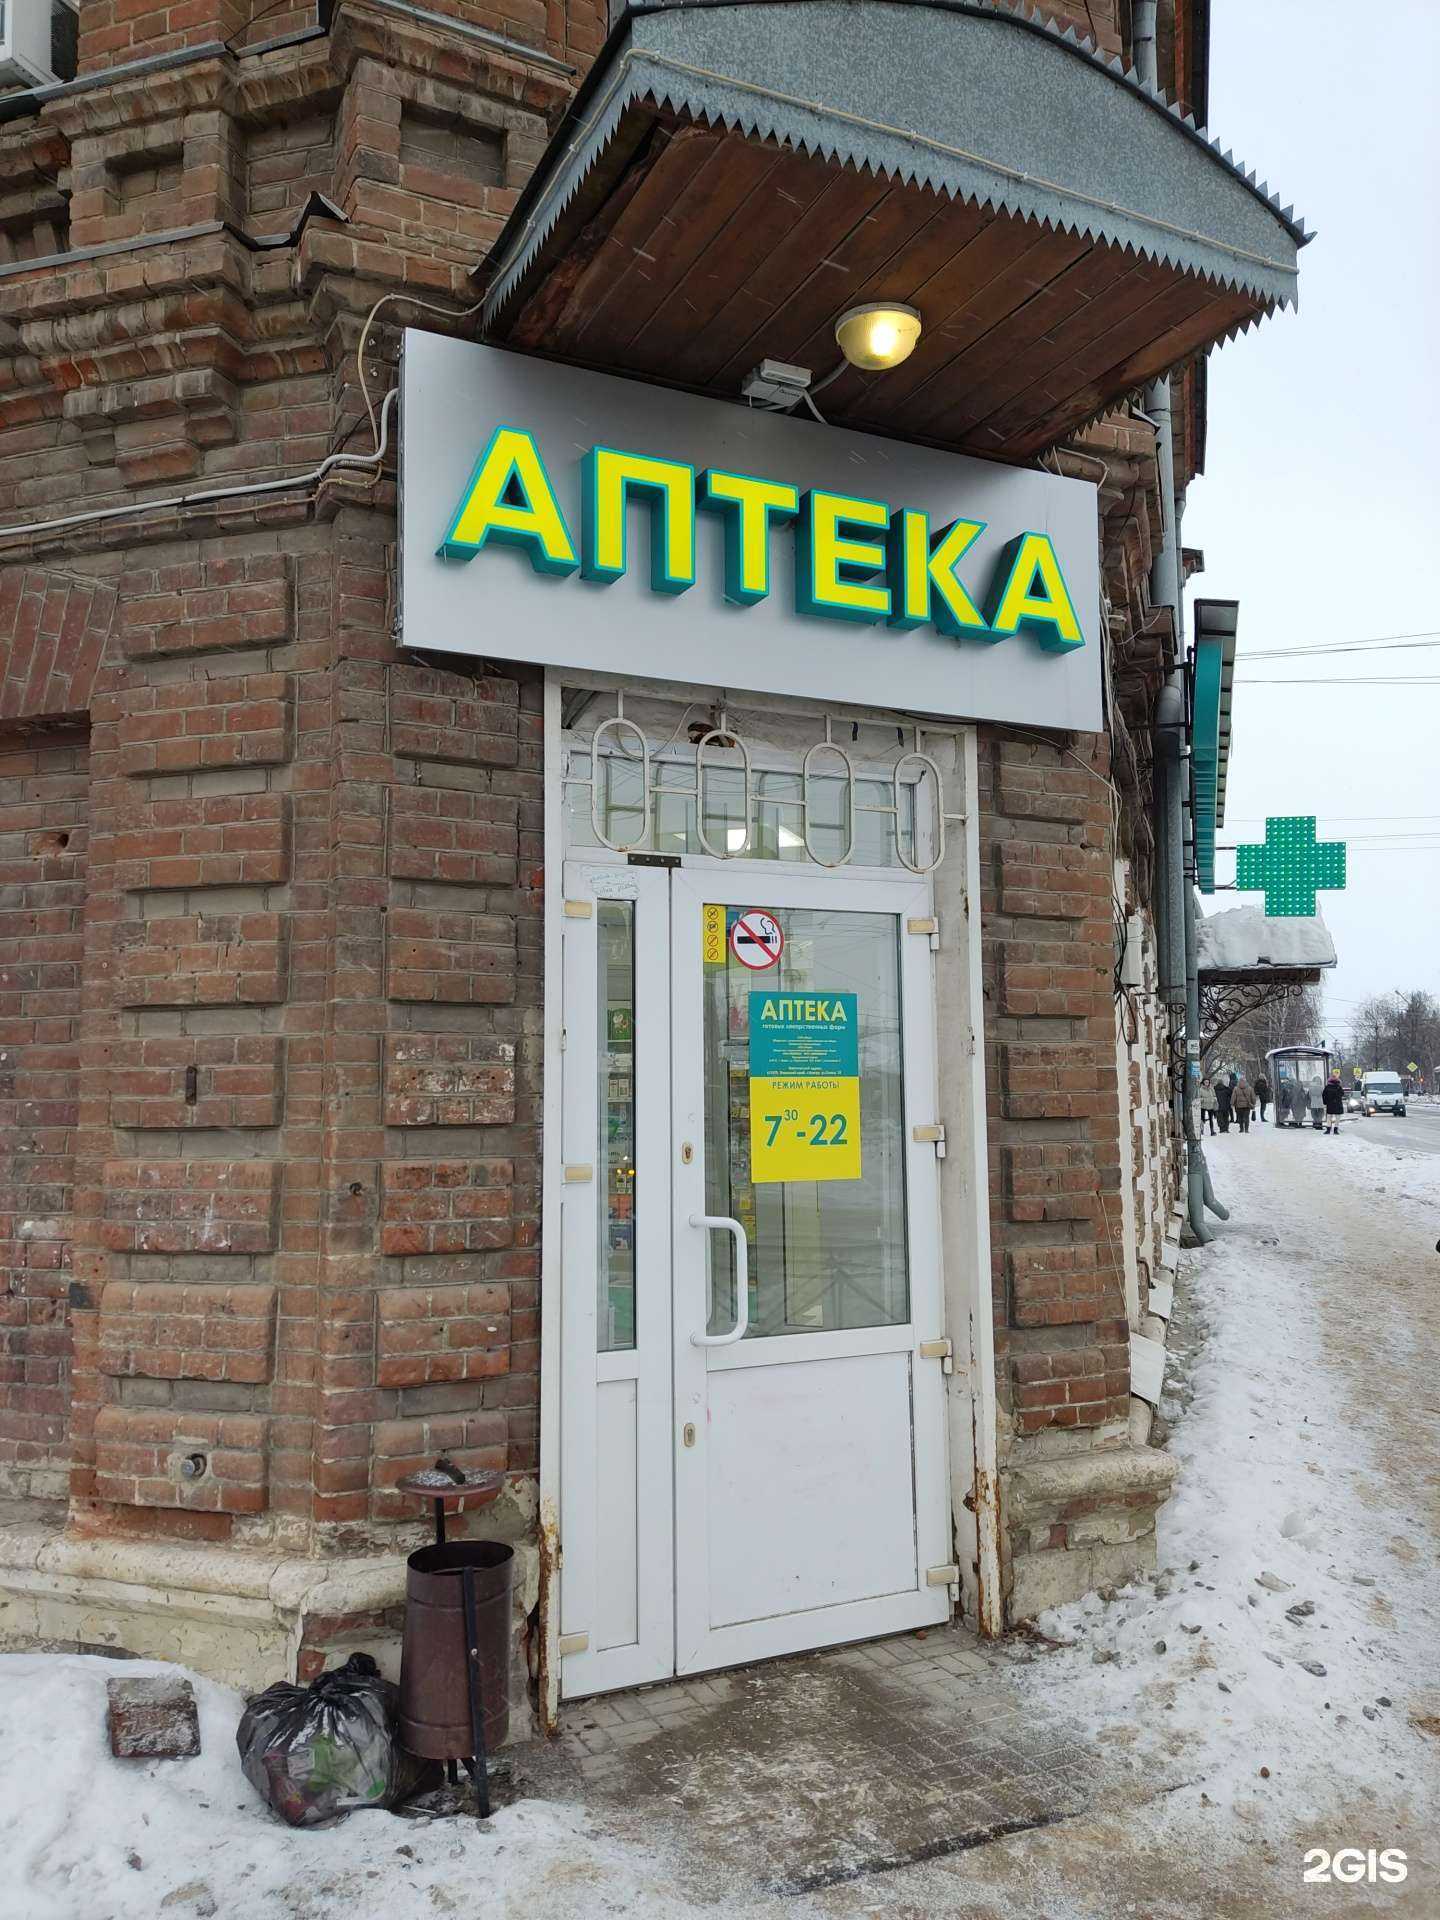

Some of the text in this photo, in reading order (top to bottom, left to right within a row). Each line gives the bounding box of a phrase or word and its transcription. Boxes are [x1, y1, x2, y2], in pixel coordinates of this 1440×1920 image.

[436, 425, 1086, 654] АПТЕКА
[760, 999, 848, 1022] АПТЕКА
[772, 1080, 840, 1089] РЕЖИМ РАБОТЫ
